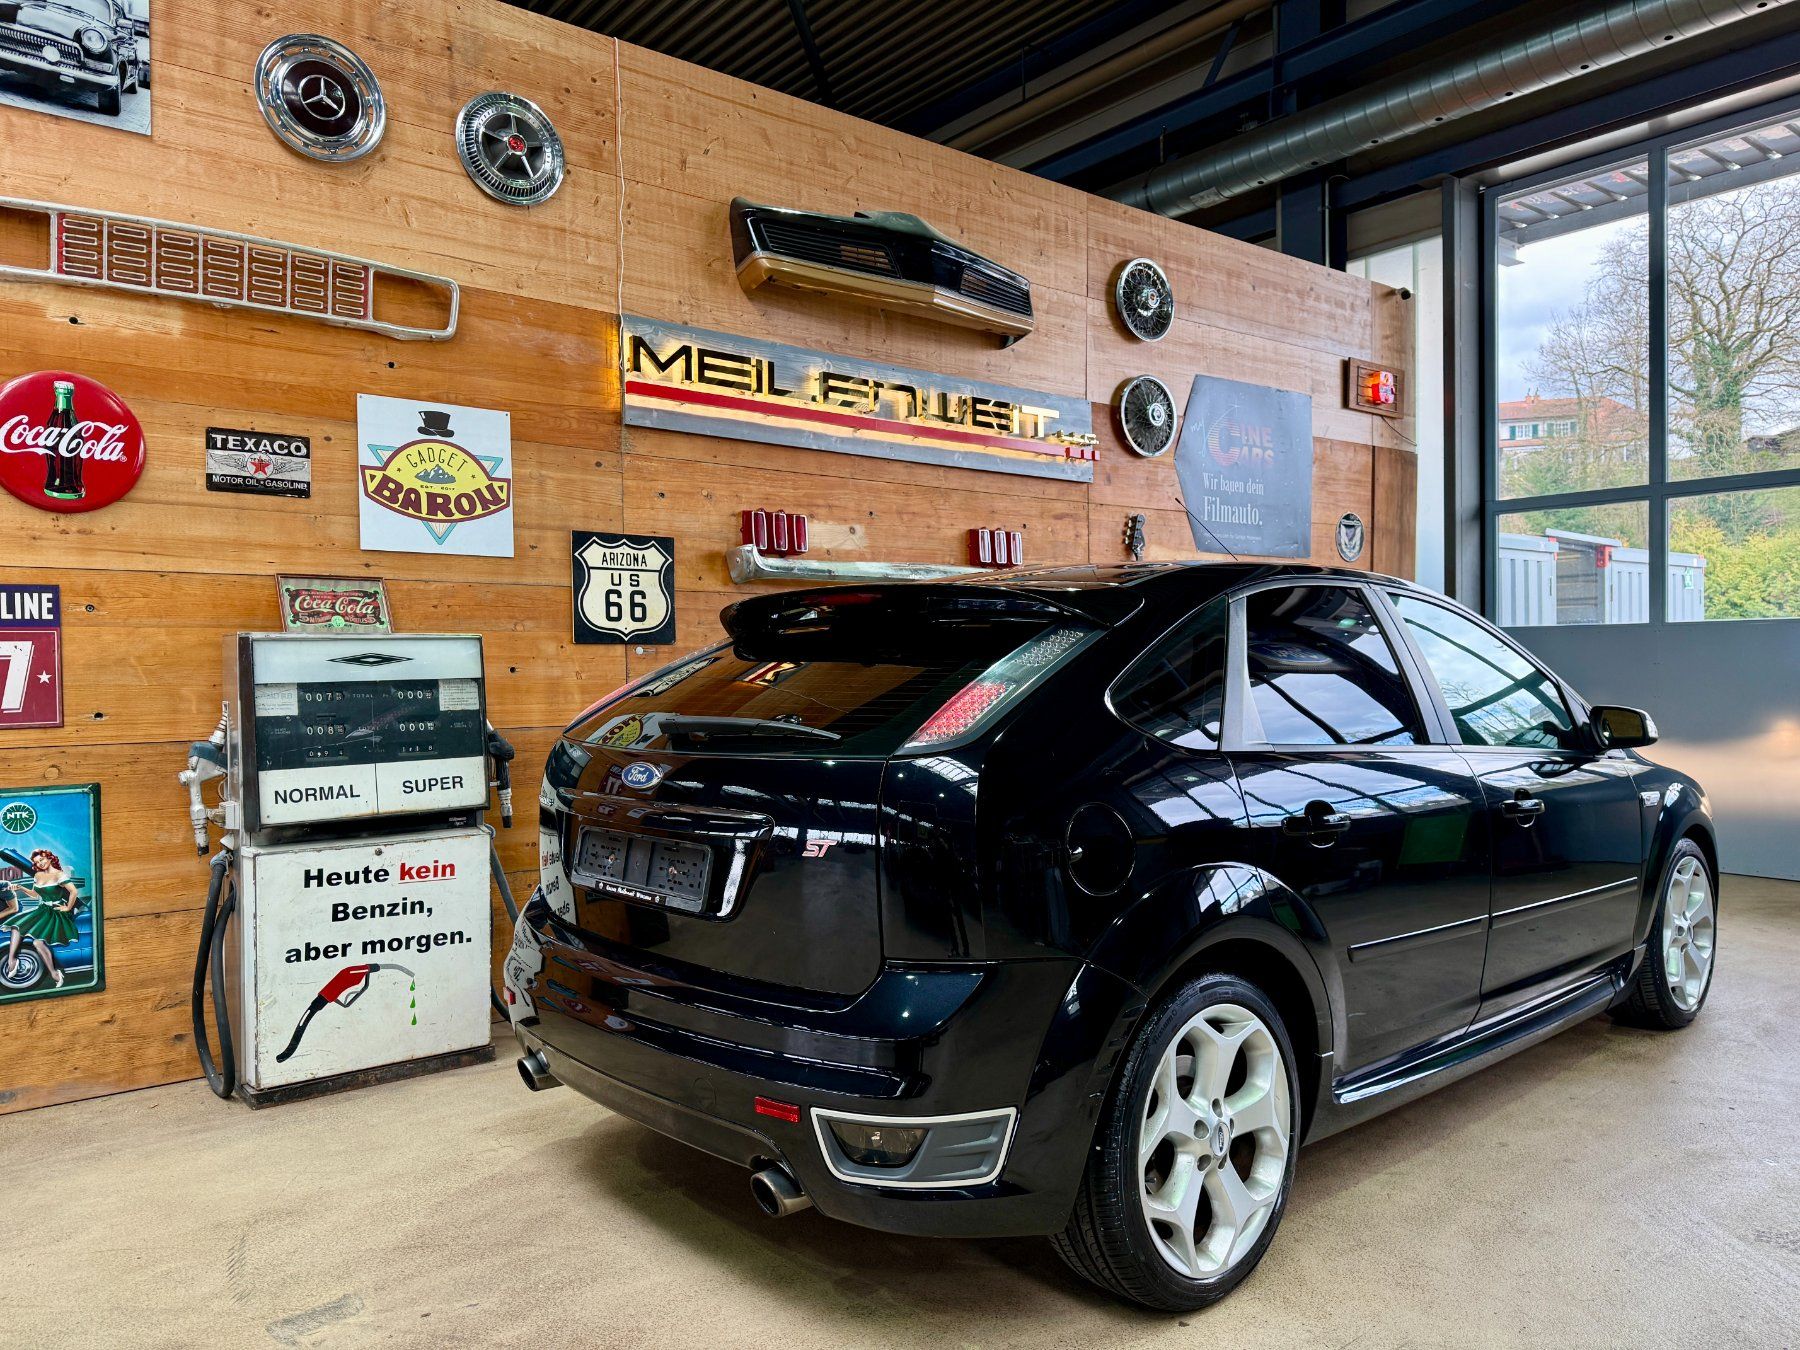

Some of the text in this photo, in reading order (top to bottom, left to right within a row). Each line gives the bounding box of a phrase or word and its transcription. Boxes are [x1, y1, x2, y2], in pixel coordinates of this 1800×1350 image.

[0, 414, 128, 462] Coca-Cola
[211, 433, 307, 456] TEXACO
[406, 447, 468, 472] GADGET
[212, 475, 308, 490] MOTOR OIL GASOLINE
[1203, 473, 1264, 495] Wir bauen dein
[371, 473, 504, 517] BARON
[1203, 496, 1263, 526] Filmauto.
[601, 552, 647, 567] ARIZONA
[1, 592, 54, 620] LINE
[605, 590, 647, 622] 66
[402, 775, 464, 795] SUPER
[628, 767, 649, 783] Ford
[273, 784, 361, 805] NORMAL
[7, 811, 30, 820] NTK
[802, 839, 838, 858] ST
[303, 859, 456, 889] Heute kein
[331, 897, 434, 923] Benzin,
[284, 928, 472, 964] aber morgen.
